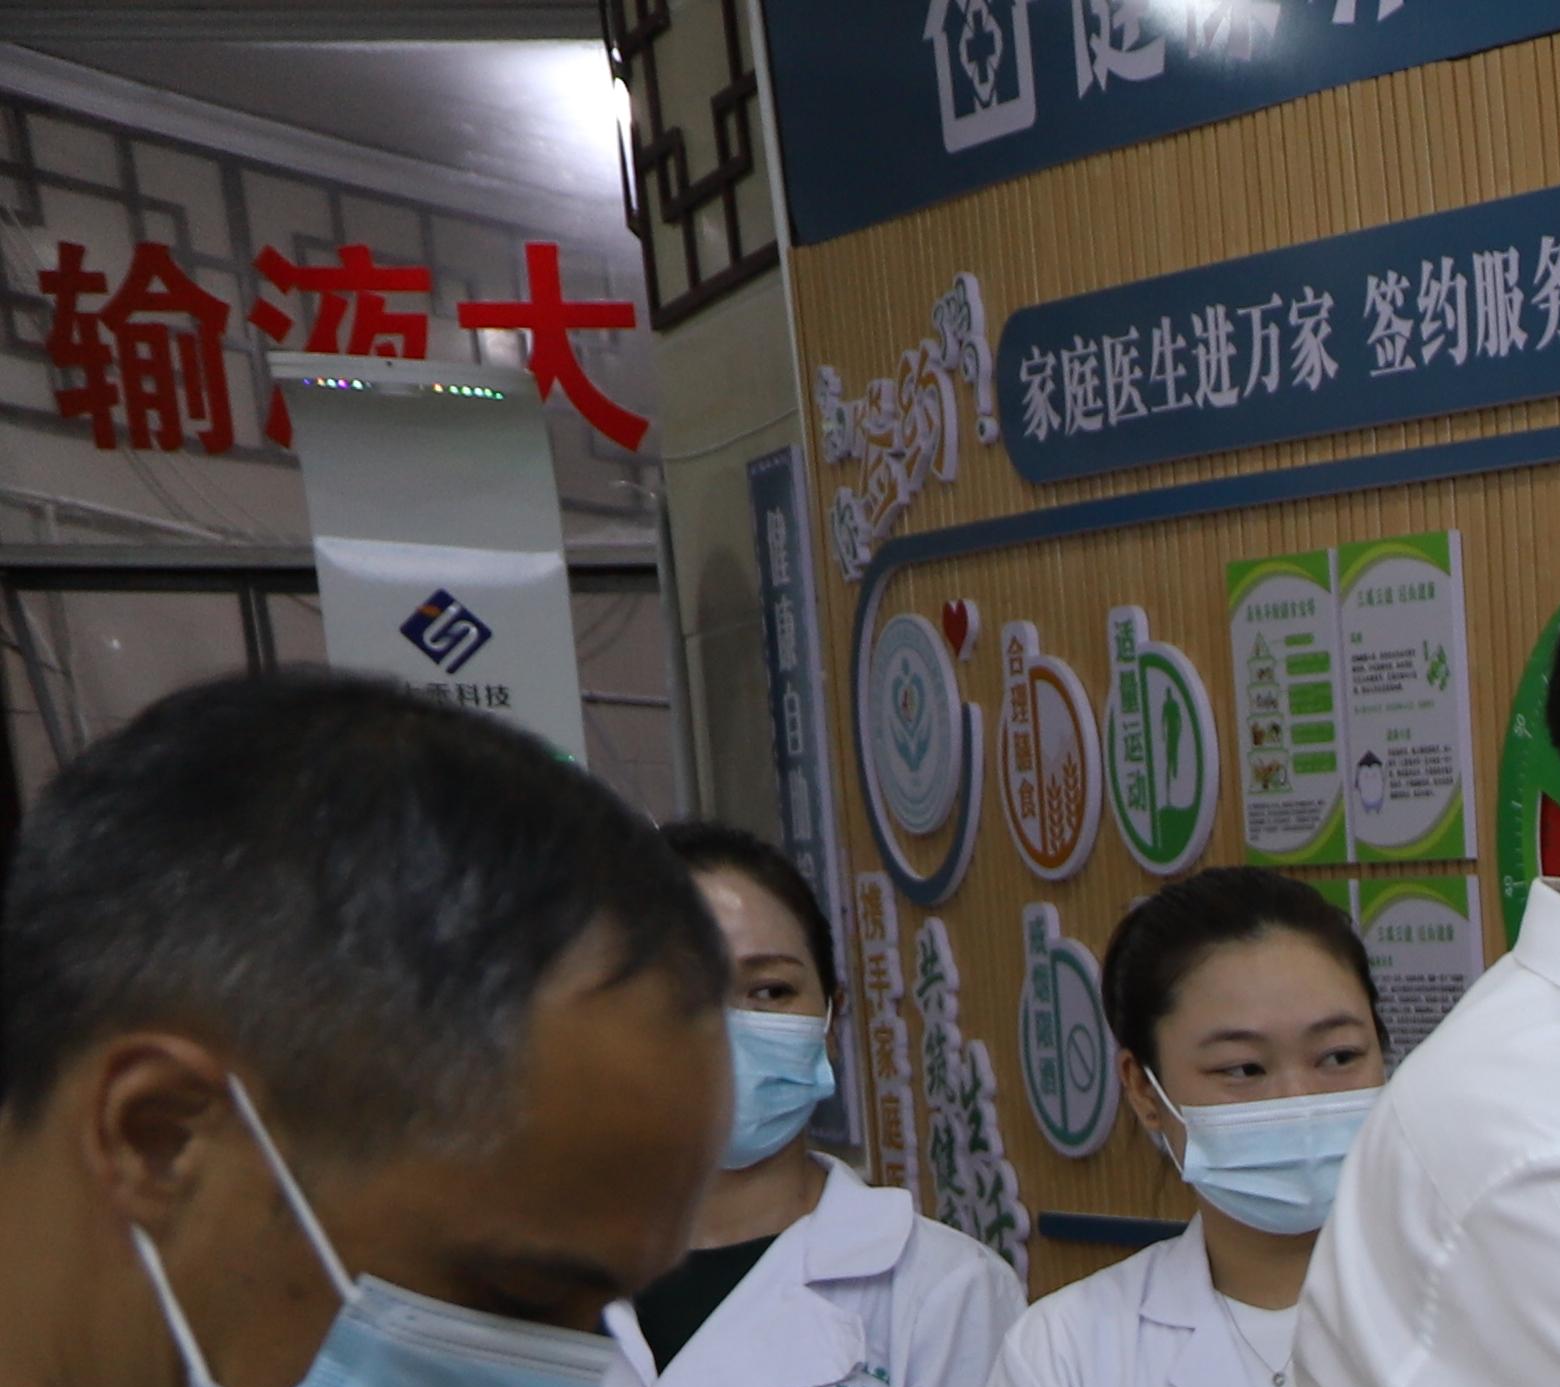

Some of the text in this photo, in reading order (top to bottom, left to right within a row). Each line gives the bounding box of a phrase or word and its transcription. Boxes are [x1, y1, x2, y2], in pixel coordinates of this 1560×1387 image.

[1018, 283, 1340, 443] 家庭医生进万家
[1006, 634, 1038, 819] 合理膳食
[1113, 620, 1149, 812] 适量运动
